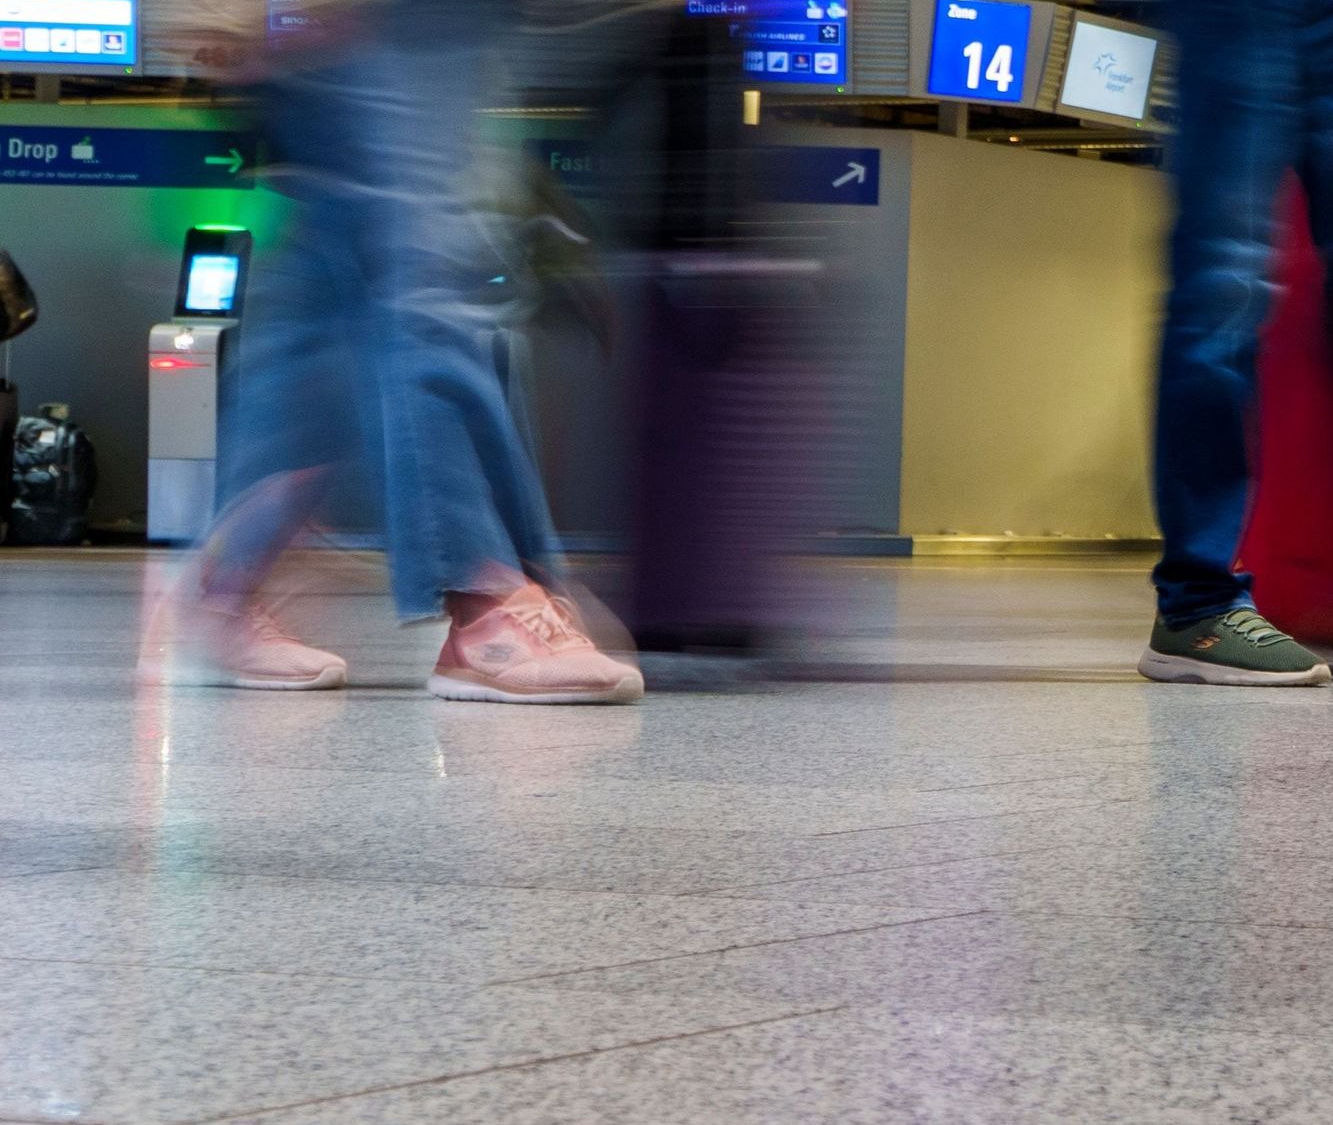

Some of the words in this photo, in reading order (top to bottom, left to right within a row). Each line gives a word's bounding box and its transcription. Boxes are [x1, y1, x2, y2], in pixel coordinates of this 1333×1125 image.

[688, 0, 748, 15] Check-in
[948, 3, 978, 20] Zone
[963, 41, 1013, 92] 14
[8, 138, 58, 163] Drop
